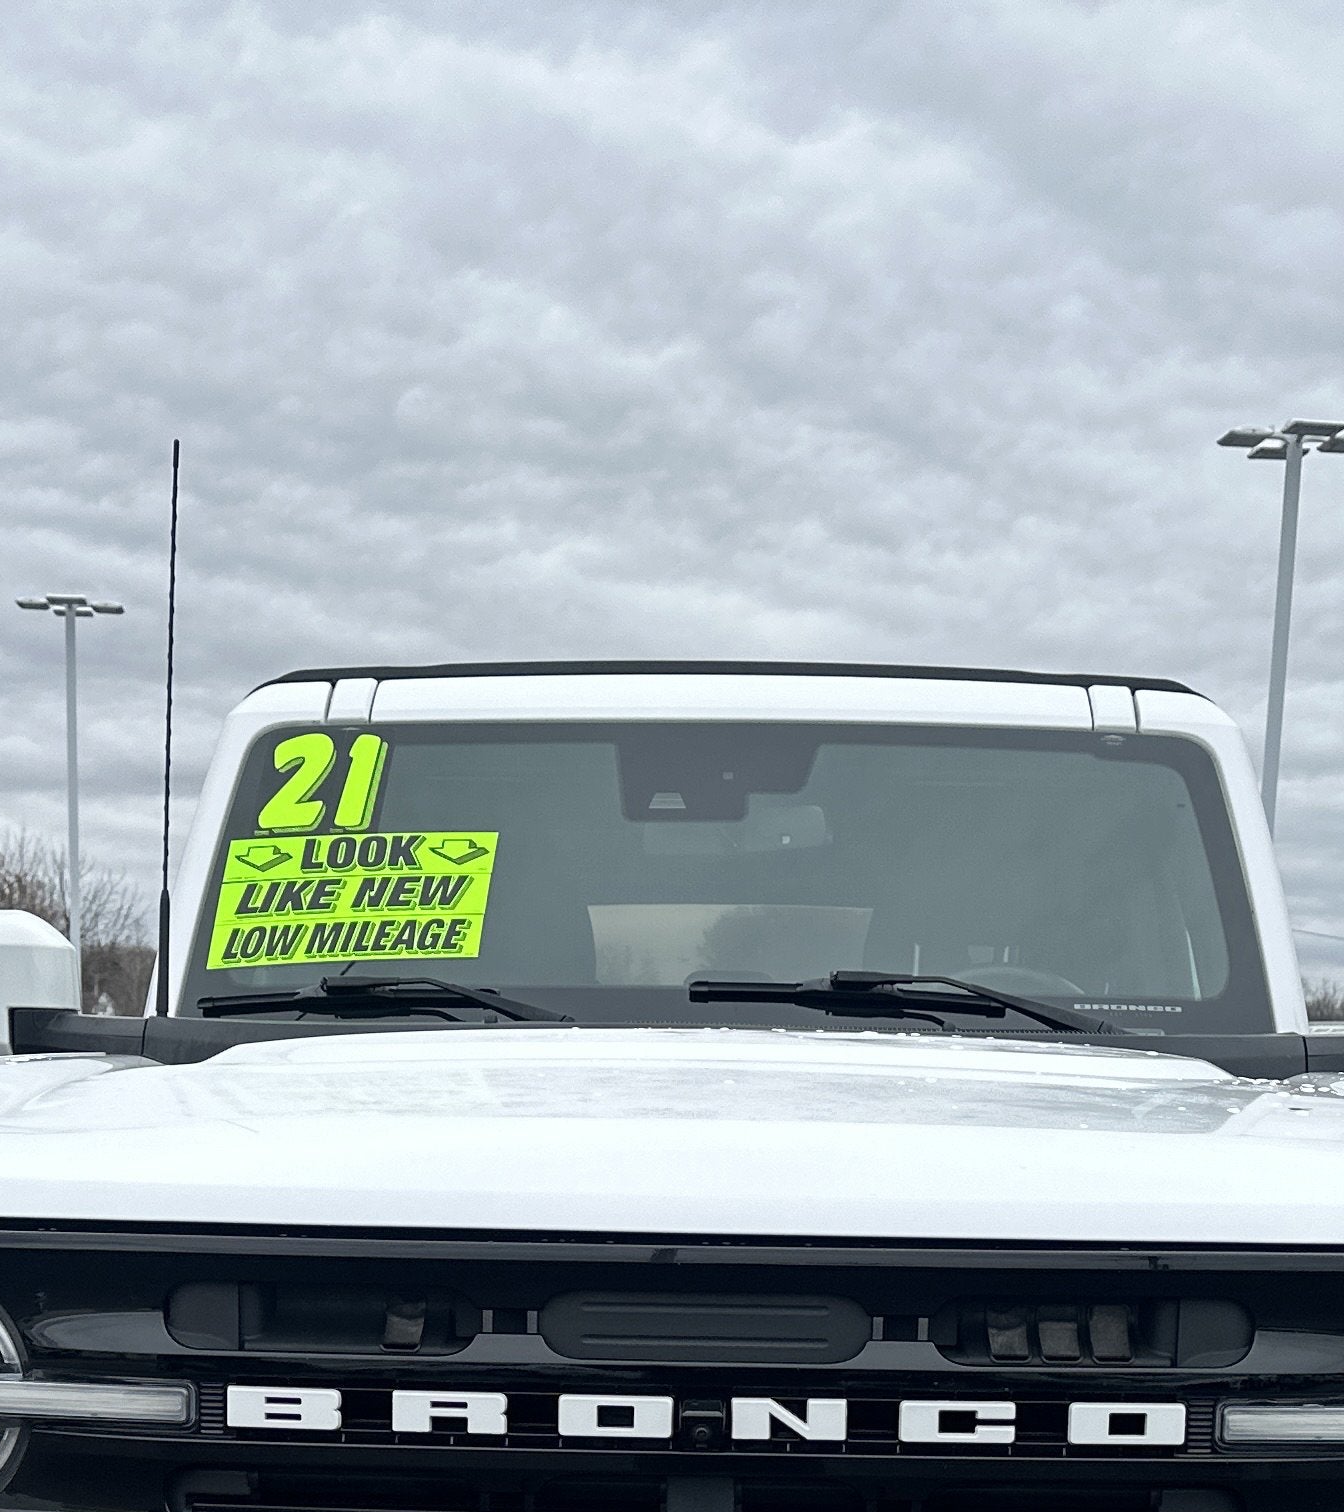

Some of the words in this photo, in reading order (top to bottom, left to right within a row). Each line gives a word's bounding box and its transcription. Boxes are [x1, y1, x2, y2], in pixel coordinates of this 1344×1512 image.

[258, 733, 388, 831] 21
[300, 835, 426, 873] LOOK
[234, 878, 346, 919] LIKE
[350, 875, 474, 912] NEW
[221, 923, 308, 963] LOW
[304, 918, 472, 959] MILEAGE
[1074, 1003, 1182, 1013] BRONCO
[226, 1384, 1186, 1446] BRONCO
